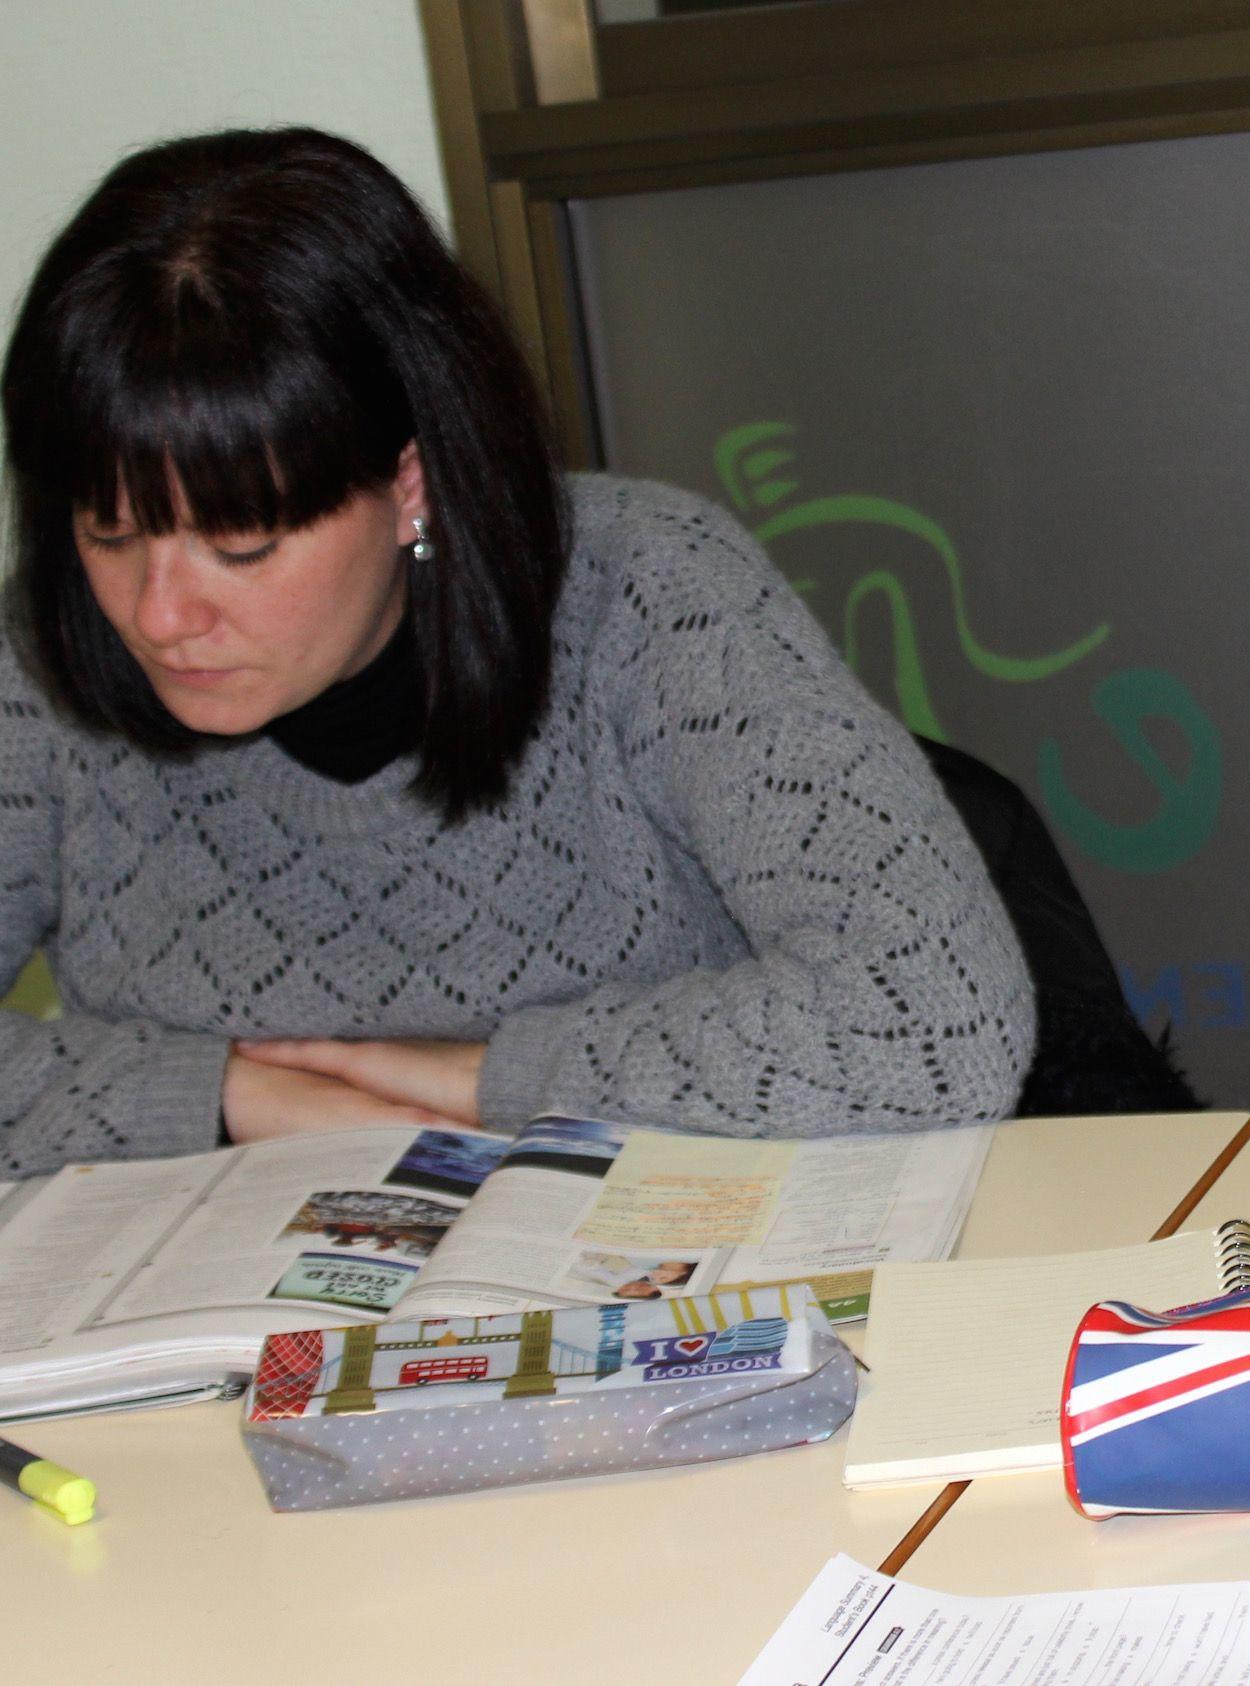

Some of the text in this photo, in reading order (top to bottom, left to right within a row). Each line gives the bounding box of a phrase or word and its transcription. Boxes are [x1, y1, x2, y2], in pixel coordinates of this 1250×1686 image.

[302, 1270, 402, 1288] CLOSED
[319, 1286, 387, 1303] Sorry
[649, 1341, 669, 1361] I
[649, 1356, 774, 1380] LONDON
[820, 1605, 847, 1633] Language
[840, 1579, 865, 1606] Summary
[852, 1598, 869, 1614] Book
